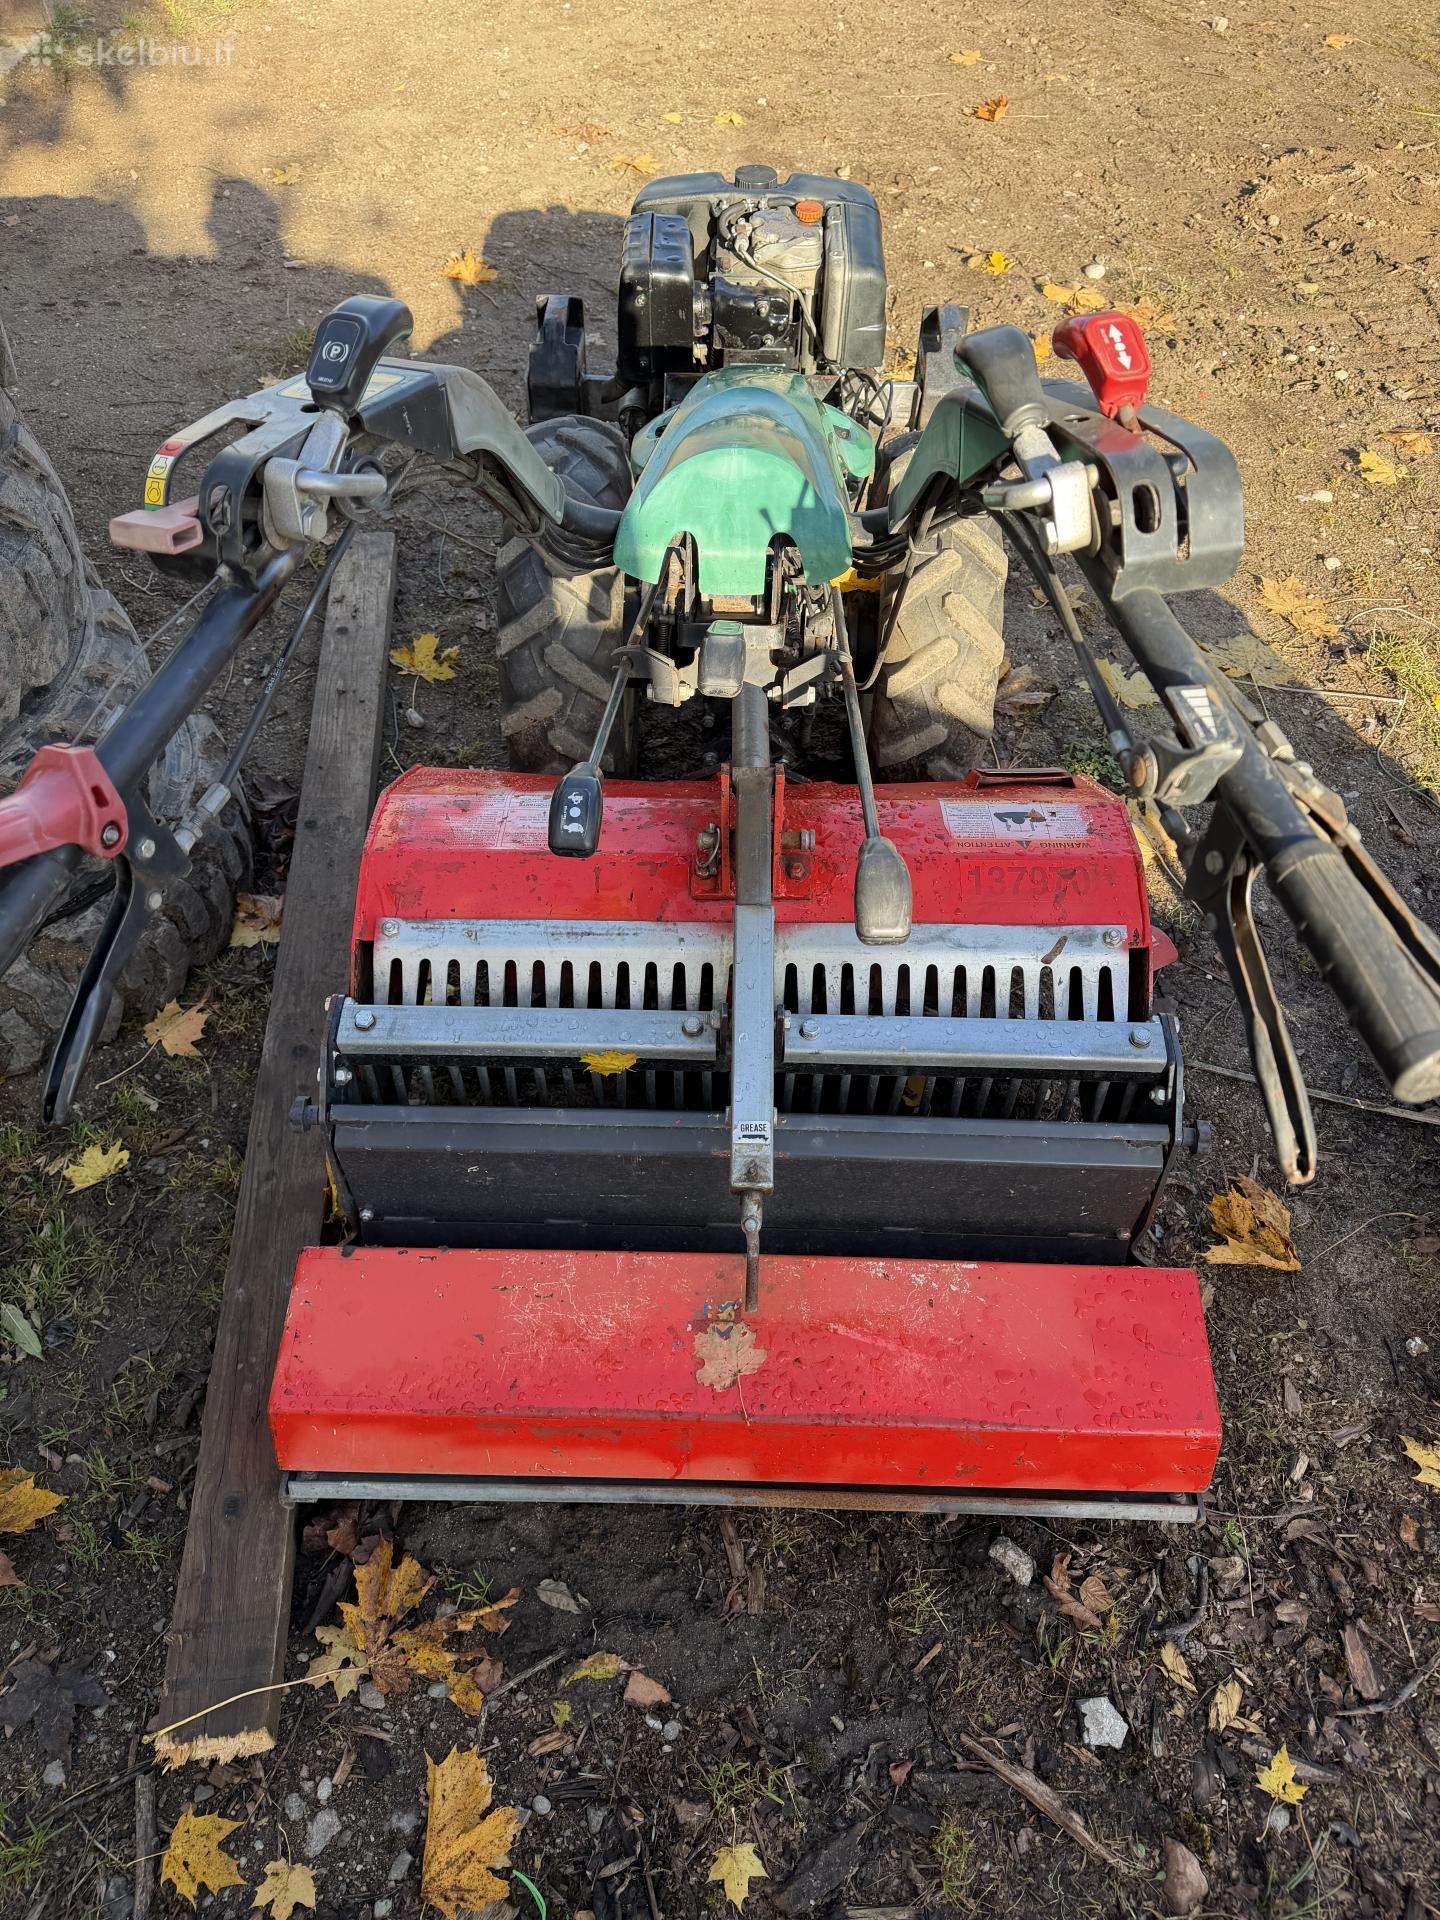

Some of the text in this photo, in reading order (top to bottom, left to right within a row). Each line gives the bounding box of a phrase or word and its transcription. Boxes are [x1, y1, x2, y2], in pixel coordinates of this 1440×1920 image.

[957, 841, 1011, 849] ATTENTION
[1040, 841, 1091, 849] WARNING
[740, 1123, 767, 1132] GREASE
